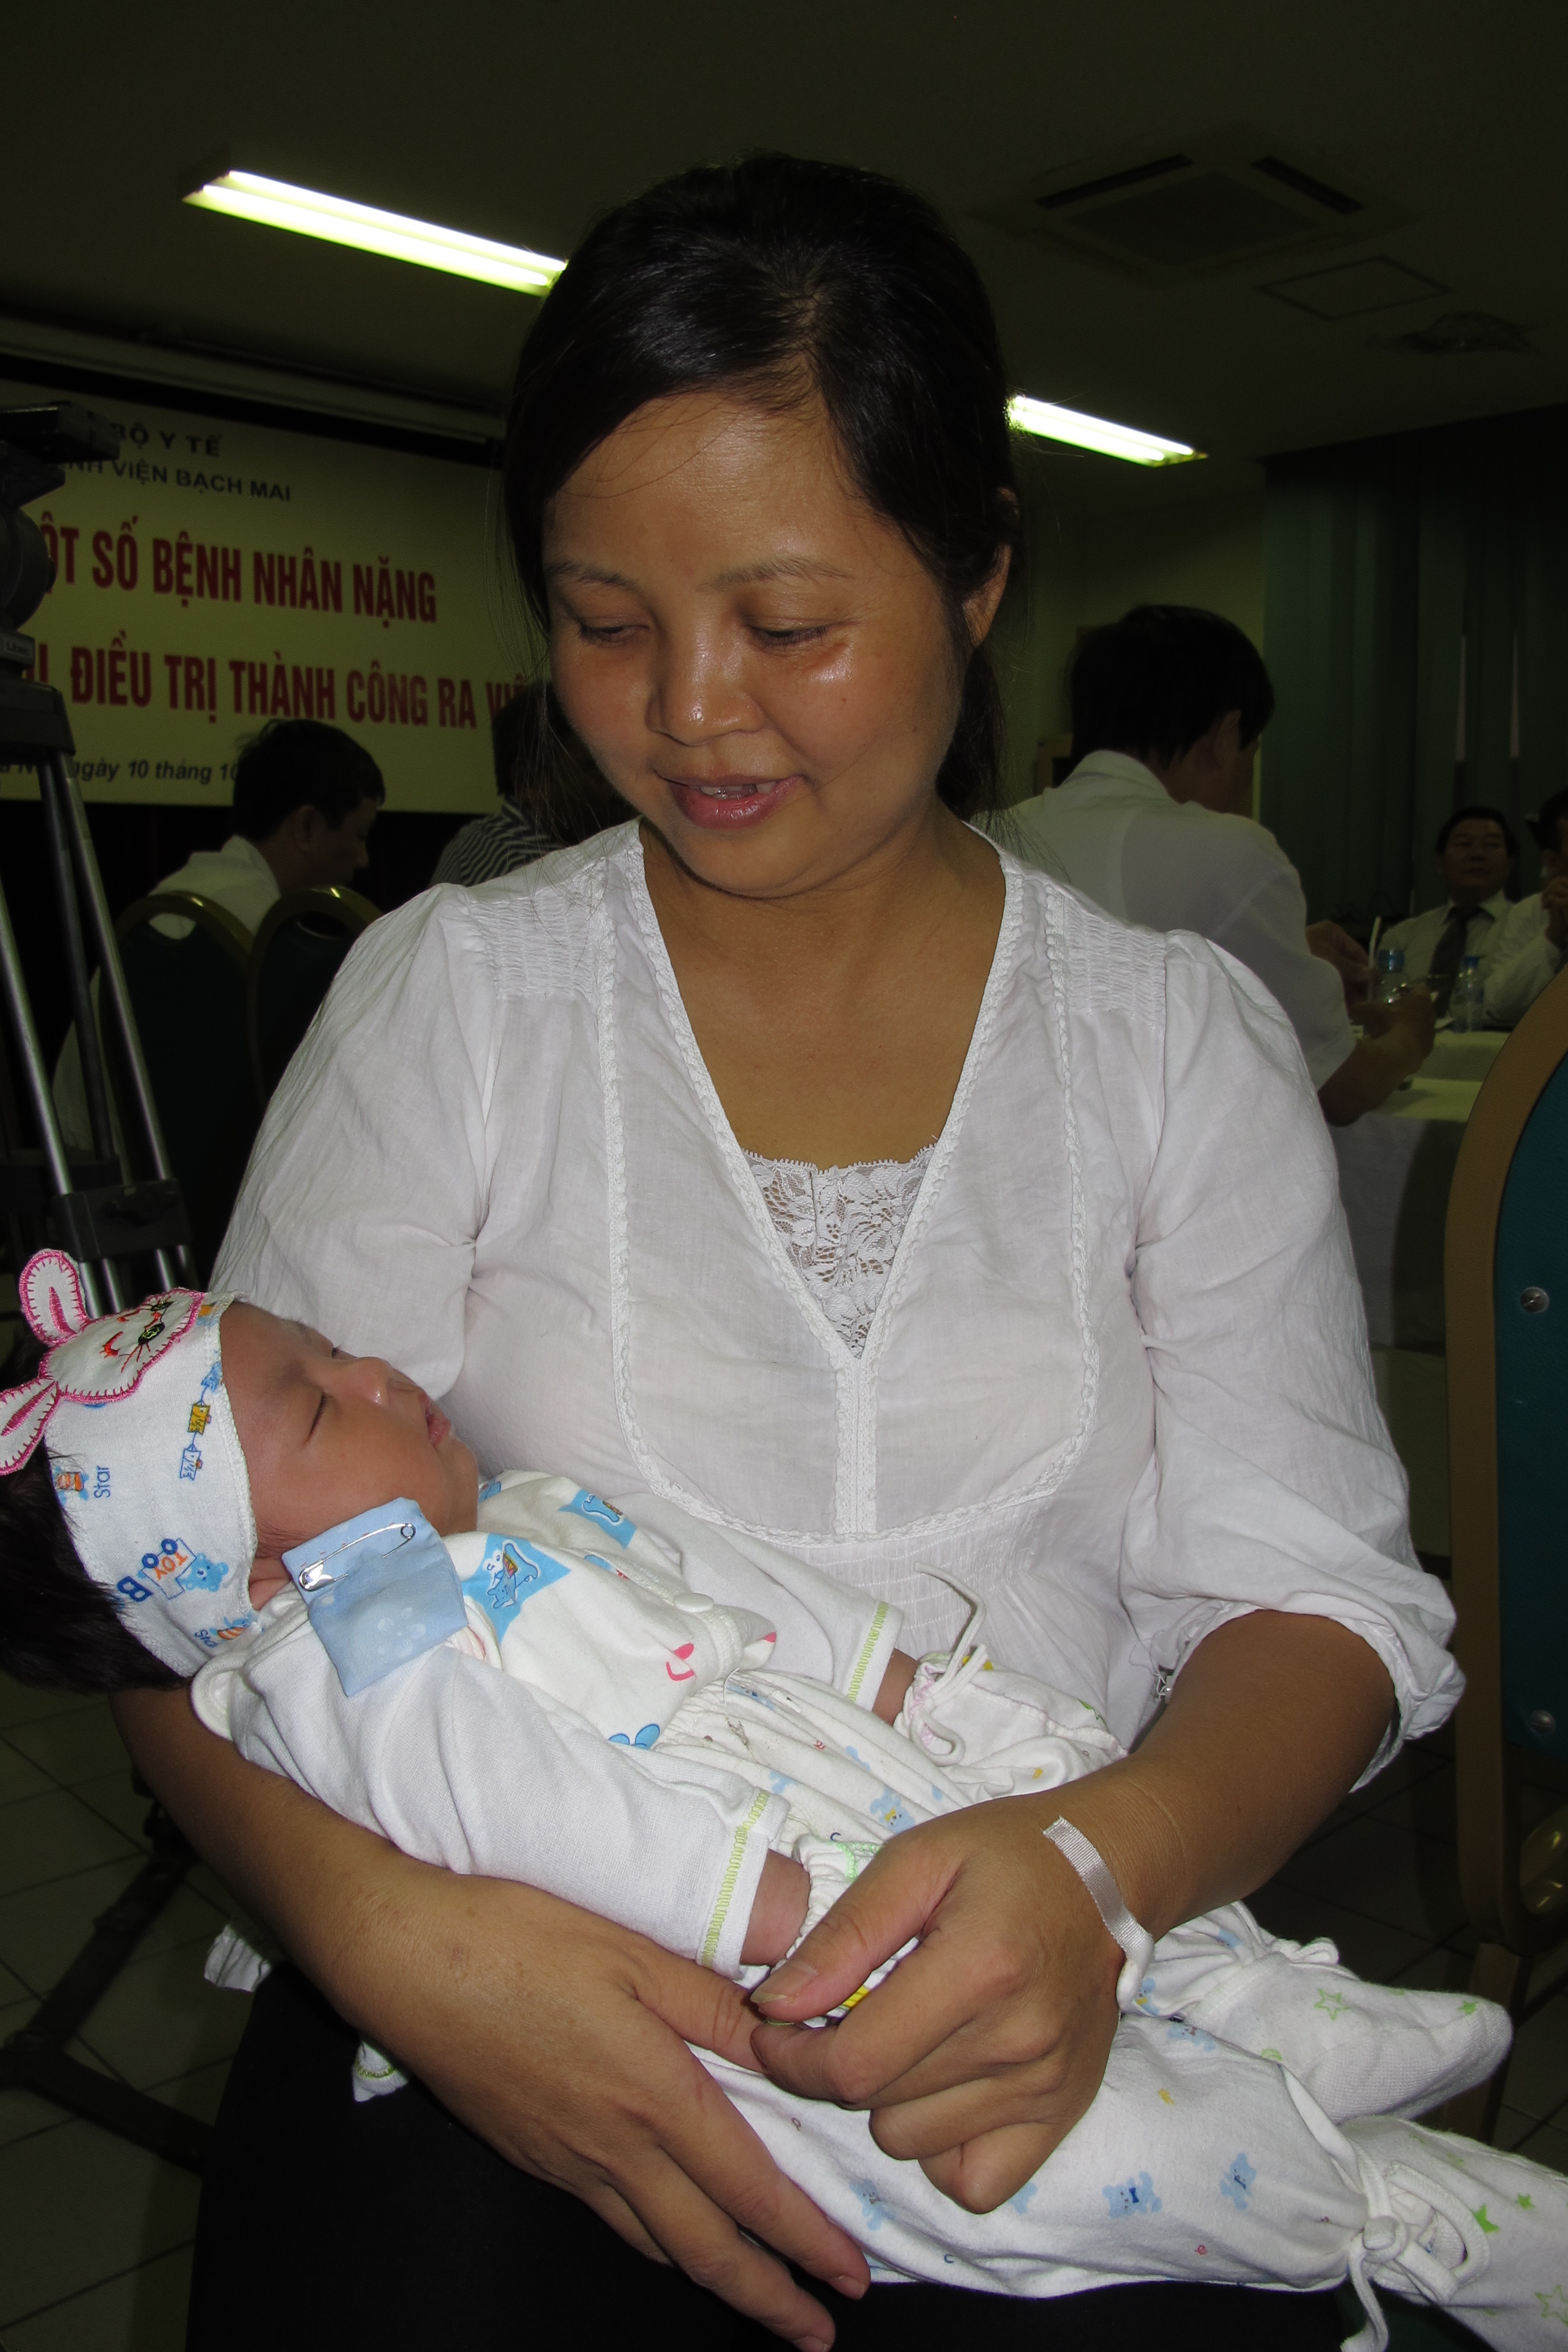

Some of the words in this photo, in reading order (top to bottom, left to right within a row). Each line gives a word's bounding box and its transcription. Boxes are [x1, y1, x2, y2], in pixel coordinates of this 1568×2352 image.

[159, 431, 176, 449] Y
[186, 433, 222, 457] TẾ
[111, 458, 168, 485] VIỆN
[176, 468, 242, 495] BẠCH
[251, 480, 291, 502] MAI
[92, 516, 139, 591] SỐ
[153, 531, 242, 607] BỆNH
[253, 546, 342, 614] NHÂN
[353, 555, 437, 629] NẶNG
[70, 630, 152, 708] ĐIỀU
[164, 654, 217, 723] TRỊ
[229, 651, 335, 721] THÀNH
[346, 660, 429, 727] CÔNG
[437, 678, 477, 729] RA
[128, 760, 150, 779] 10
[155, 759, 212, 785] tháng
[93, 1465, 111, 1498] Star
[153, 1551, 189, 1580] TOY
